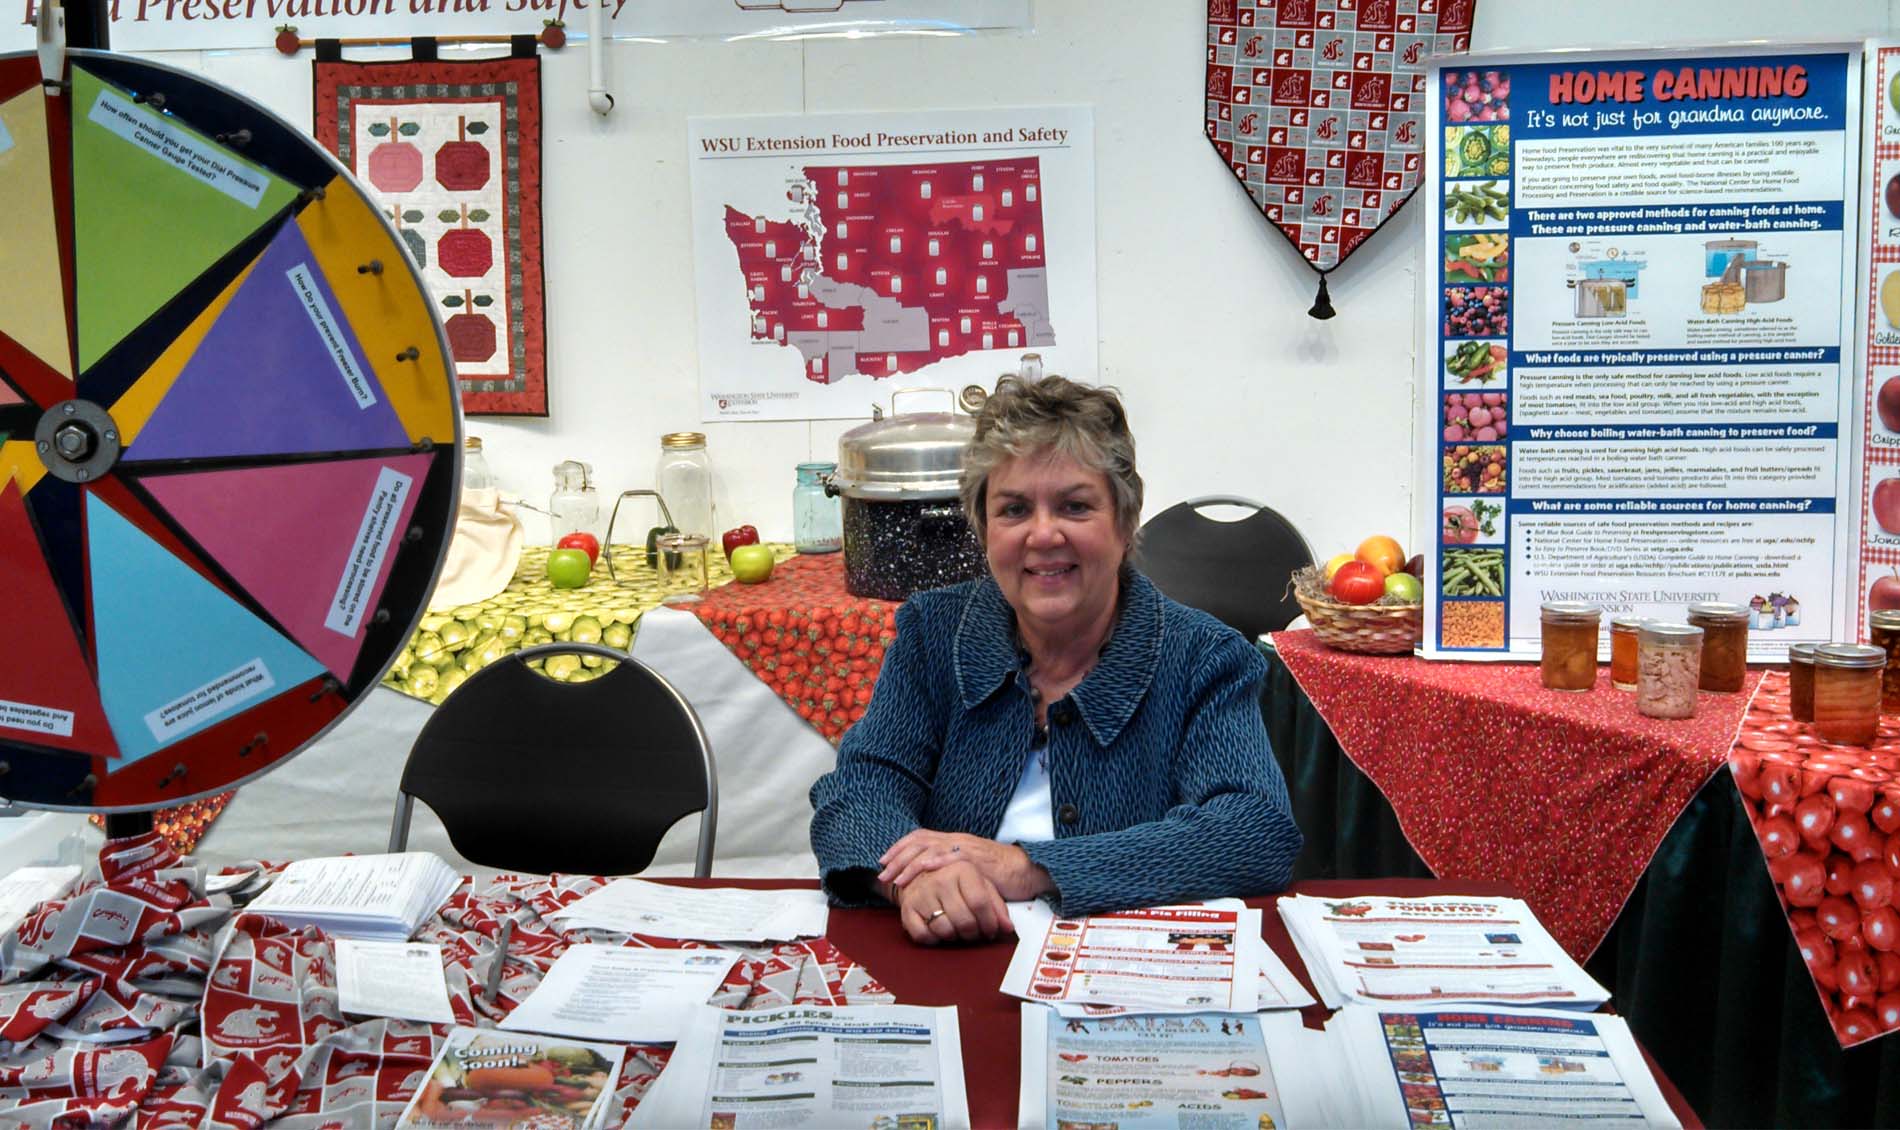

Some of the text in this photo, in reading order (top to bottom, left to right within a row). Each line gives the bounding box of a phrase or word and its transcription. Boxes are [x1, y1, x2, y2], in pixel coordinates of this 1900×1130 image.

[1549, 65, 1807, 104] HOME CANNING
[1527, 104, 1828, 130] It's not just for grandma anymore.
[100, 99, 260, 192] How often should you get your Dial Pressure
[702, 127, 1068, 152] WSU Extension Food Preservation and Safety
[133, 131, 217, 181] Canner Gauge Tested?
[1528, 204, 1826, 221] There are two approved methods for canning foods at home.
[1531, 218, 1822, 236] These are pressure canning and water-bath canning.
[295, 273, 368, 400] How Do your prevent Freezer Burn?
[1525, 348, 1824, 364] What foods are typically preserved using a pressure canner?
[1530, 425, 1817, 439] Why choose boiling water-bath canning to preserve food?
[1532, 499, 1812, 512] What are some reliable sources for home canning?
[1176, 910, 1220, 918] Filling
[726, 1010, 833, 1024] PICKLES
[1437, 1014, 1574, 1028] HOME CANNING
[454, 1044, 537, 1058] Coming
[1096, 1055, 1160, 1063] TOMATOES
[1096, 1078, 1163, 1086] PEPPERS
